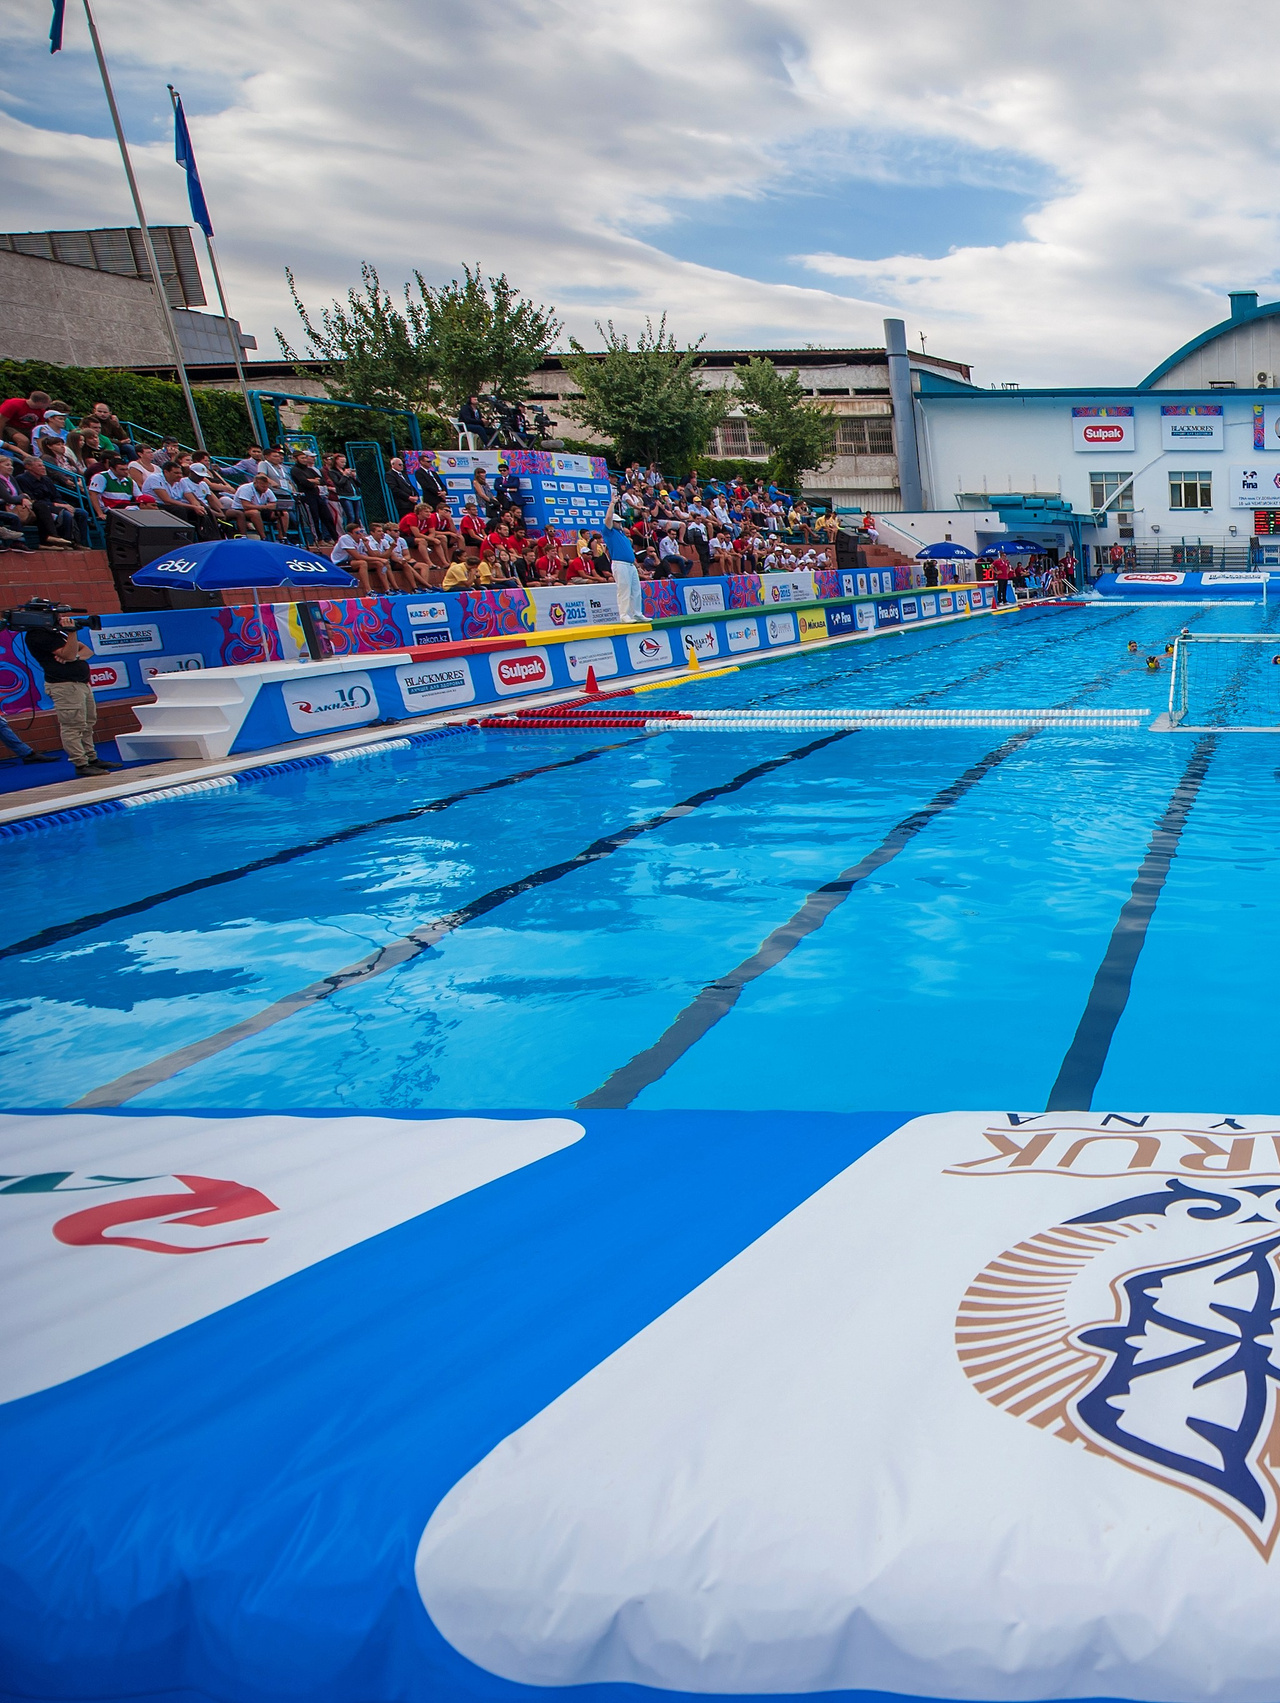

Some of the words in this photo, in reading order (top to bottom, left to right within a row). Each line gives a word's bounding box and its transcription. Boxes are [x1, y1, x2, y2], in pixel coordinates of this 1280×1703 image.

[1085, 428, 1122, 440] Sulpak
[1242, 480, 1258, 489] Fina
[982, 569, 994, 580] 30
[567, 608, 587, 620] 2015
[841, 612, 852, 623] Fina
[98, 630, 152, 641] BLACKMORES
[419, 634, 448, 645] zakon.kz
[500, 660, 543, 680] Sulpak
[404, 669, 464, 687] BLACKMORES
[292, 700, 357, 713] RAKHAT
